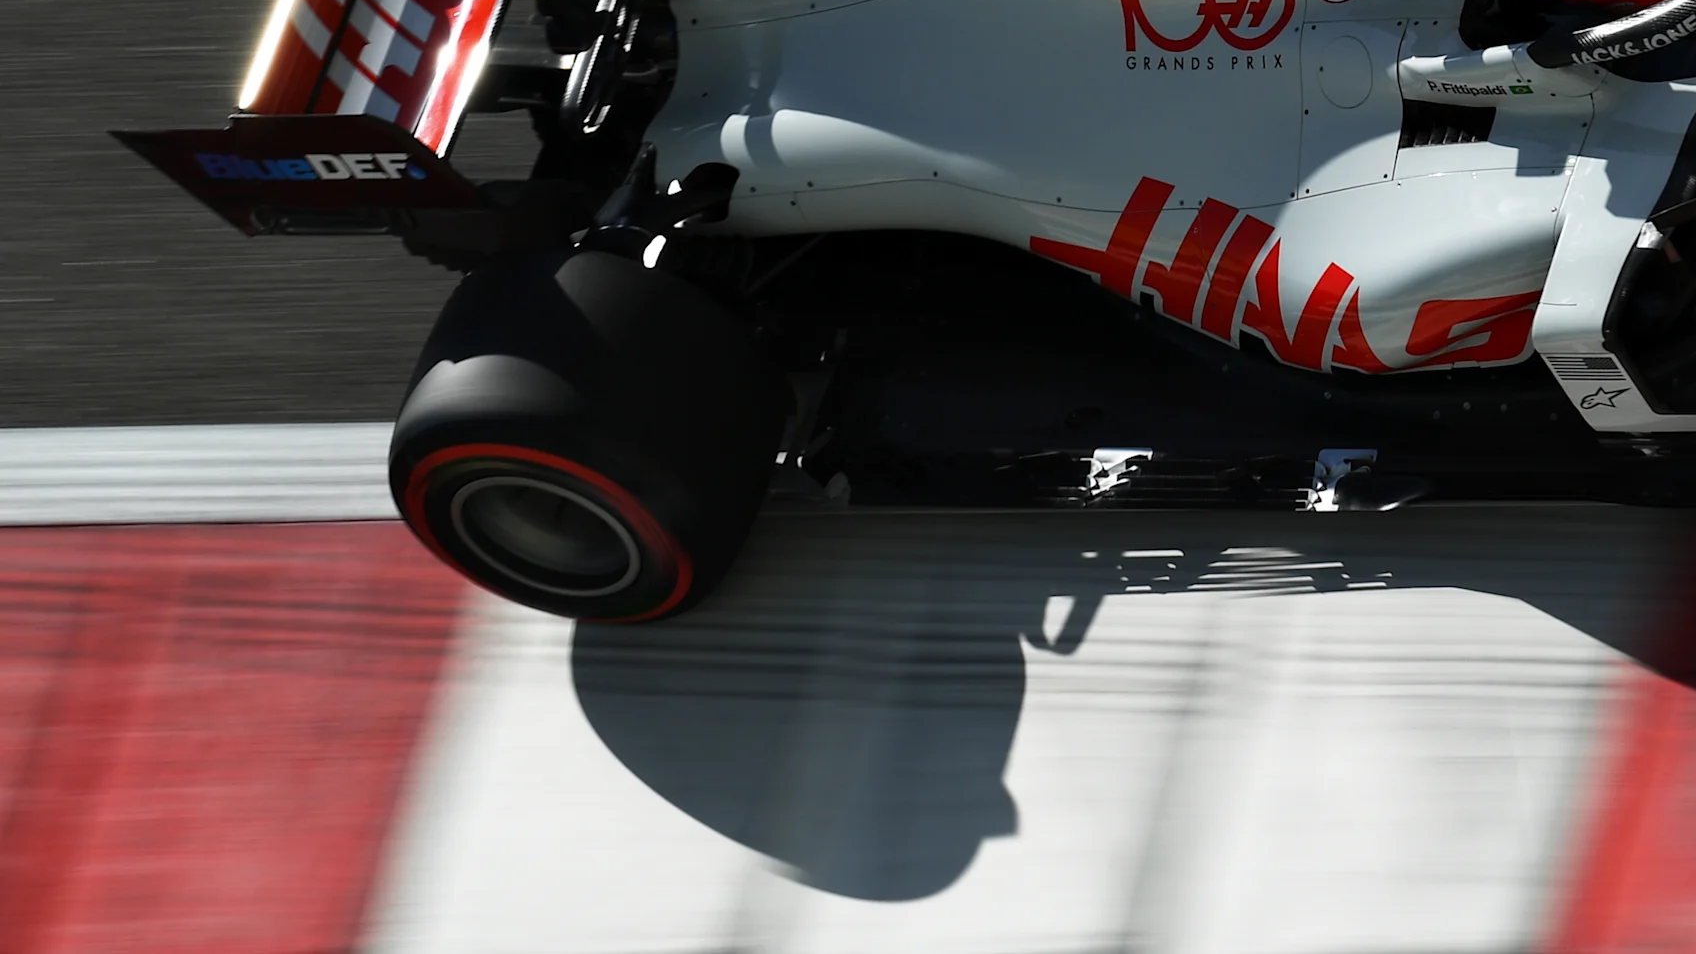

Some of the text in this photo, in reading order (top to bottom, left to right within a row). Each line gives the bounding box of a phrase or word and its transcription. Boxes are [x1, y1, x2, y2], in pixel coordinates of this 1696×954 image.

[1126, 55, 1283, 70] GRANDS PRIX
[1427, 80, 1507, 96] P. Fittipaldi
[195, 152, 411, 180] BlueDEF
[1030, 176, 1540, 373] HAAS
